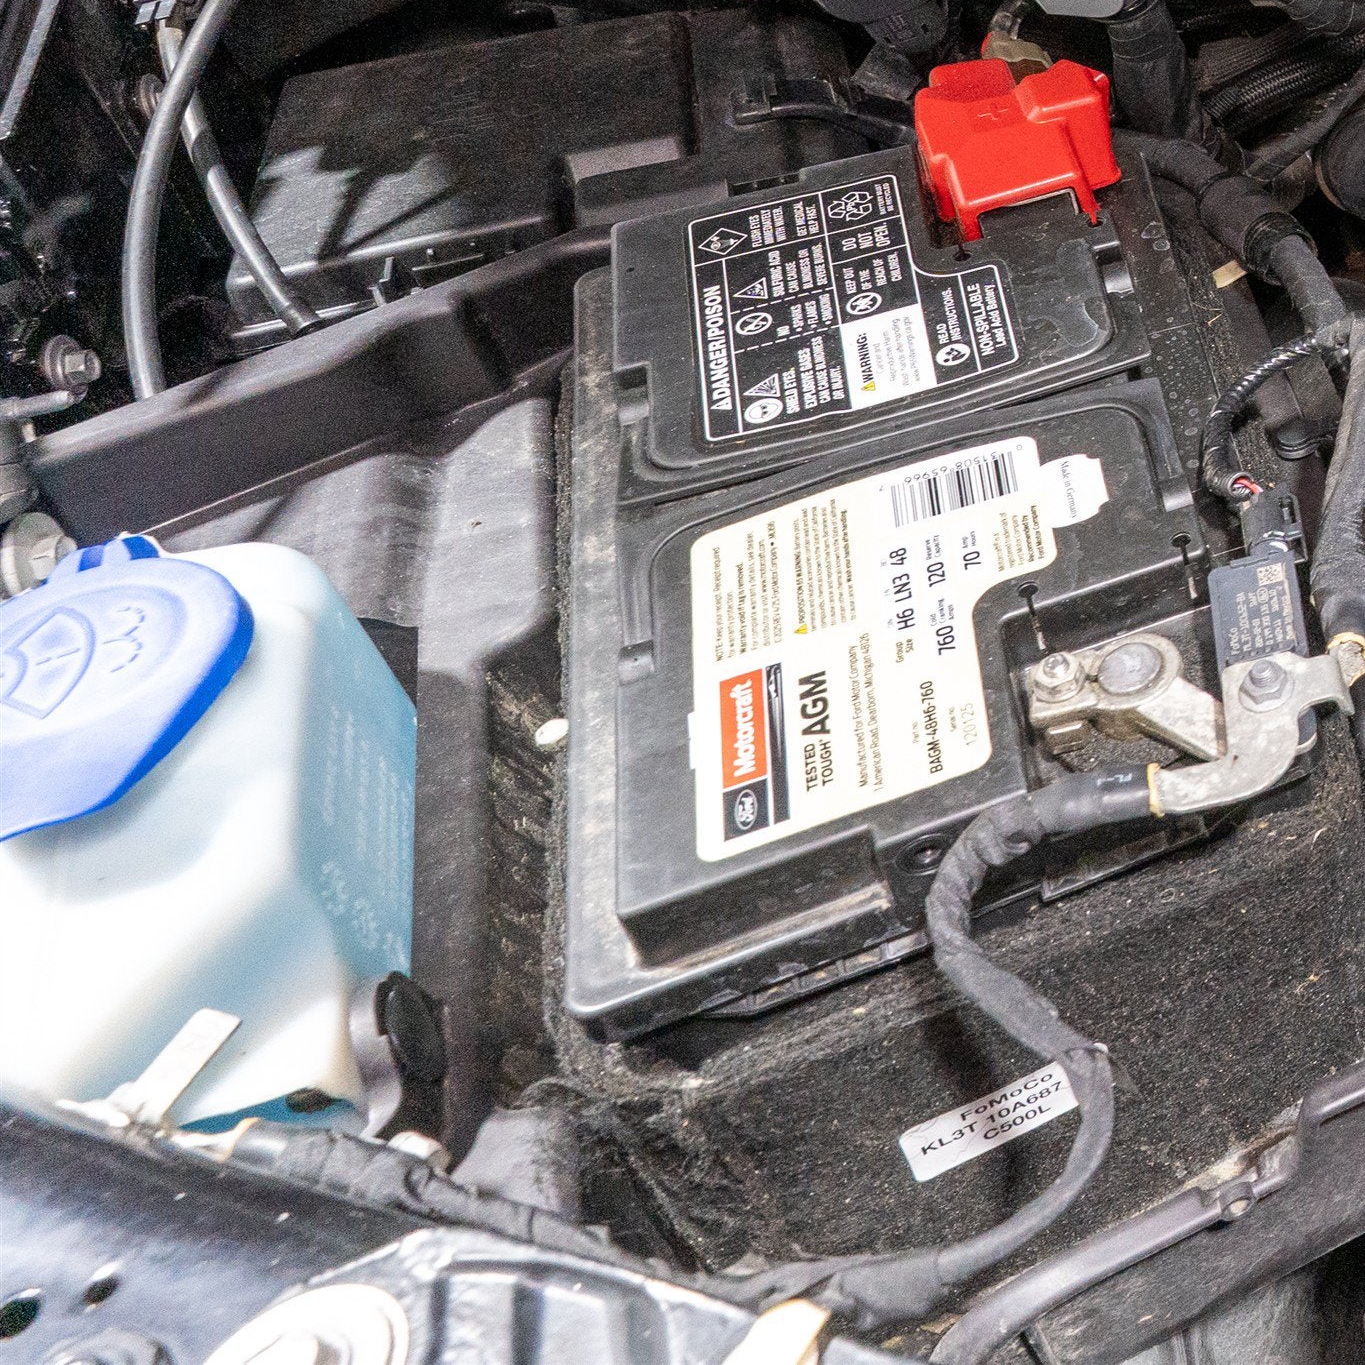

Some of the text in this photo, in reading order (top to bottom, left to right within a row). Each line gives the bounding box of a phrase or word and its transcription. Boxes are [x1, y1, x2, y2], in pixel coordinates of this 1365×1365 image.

[772, 205, 786, 242] WITH WATER.
[793, 200, 807, 236] GET MEDICAL
[805, 203, 819, 234] HELP FAST.
[846, 201, 856, 211] Pb
[748, 214, 762, 247] FLUSH EYES
[760, 209, 774, 245] IMMEDIATELY
[841, 237, 857, 251] DO
[858, 231, 873, 248] NOT
[873, 221, 890, 247] OPEN.
[767, 249, 785, 297] SULFURIC ACID
[785, 260, 799, 293] CAN CAUSE
[798, 248, 813, 289] BLINDNESS OR
[812, 241, 828, 286] SEVERE BURNS.
[842, 266, 857, 294] KEEP OUT
[859, 268, 872, 290] OF THE
[872, 257, 887, 286] REACH OF
[887, 251, 902, 282] CHILDREN.
[776, 324, 790, 337] NO
[941, 287, 962, 342] INSTRUCTIONS.
[966, 283, 994, 357] NON-SPILLABLE
[983, 284, 1006, 347] Lead Acid Battery
[703, 285, 730, 399] DANGER/POISON
[936, 322, 949, 344] READ
[810, 335, 831, 404] CAN CAUSE BLINDNESS
[855, 332, 873, 383] WARNING:
[781, 366, 800, 414] SHIELD EYES.
[797, 347, 817, 409] EXPLOSIVE GASES
[829, 365, 845, 400] OR INJURY.
[926, 561, 945, 587] 120
[962, 550, 981, 570] 70
[889, 546, 915, 630] H6 LN3 48
[859, 632, 870, 654] 48126
[895, 640, 904, 663] Group
[905, 638, 913, 653] Size
[935, 624, 955, 655] 760
[862, 654, 874, 688] Michigan
[798, 671, 830, 735] AGM
[848, 644, 868, 787] Manufactured for Ford Motor Company
[730, 680, 755, 776] Motorcraft
[919, 680, 943, 773] BAGM-48H6-760
[960, 702, 977, 746] 120125
[803, 742, 817, 791] TESTED
[871, 748, 883, 786] American
[737, 794, 755, 825] Ford
[956, 1074, 1056, 1120] FoMoCo
[920, 1081, 1060, 1155] KL3T 10A687
[979, 1105, 1054, 1140] C500L
